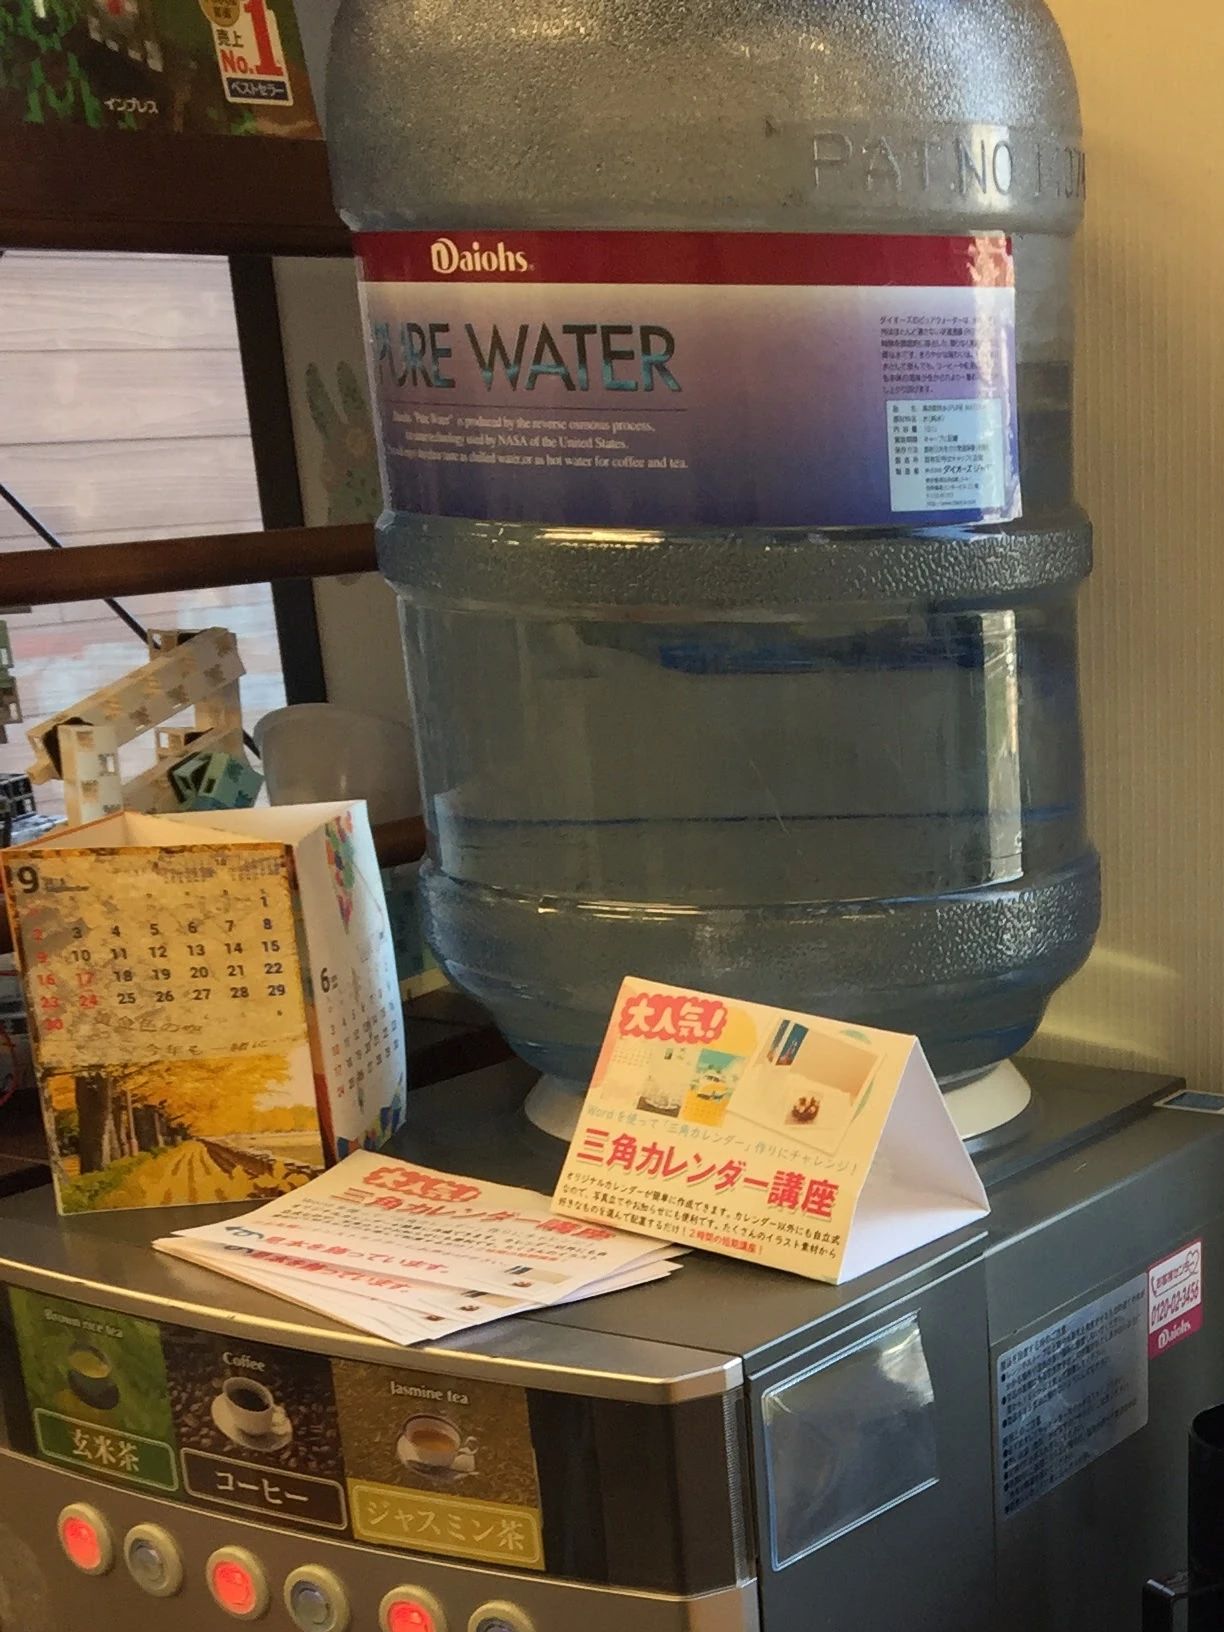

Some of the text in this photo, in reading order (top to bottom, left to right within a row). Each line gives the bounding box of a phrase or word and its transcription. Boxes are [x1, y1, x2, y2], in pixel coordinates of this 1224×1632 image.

[217, 29, 244, 48] 売上
[231, 81, 285, 97] ベストセラー
[430, 238, 528, 274] Daiohs
[465, 322, 683, 392] WATER
[612, 456, 667, 468] coffee and
[17, 866, 39, 893] 9
[260, 896, 269, 907] 1
[72, 918, 273, 939] 3 4 5 6 7 8
[72, 940, 280, 962] 10 11 12 13 14 15
[76, 962, 284, 984] 17 18 19 20 21 22
[117, 984, 286, 1004] 25 26 27 28 29
[626, 1003, 721, 1041] 大人気!
[576, 1127, 840, 1218] 三角カレンダー講座
[222, 1351, 266, 1373] Coffee
[390, 1381, 469, 1405] Jasmine tea
[71, 1428, 141, 1472] 玄米茶
[215, 1471, 309, 1505] コーヒー
[367, 1502, 527, 1551] ジャスミン茶
